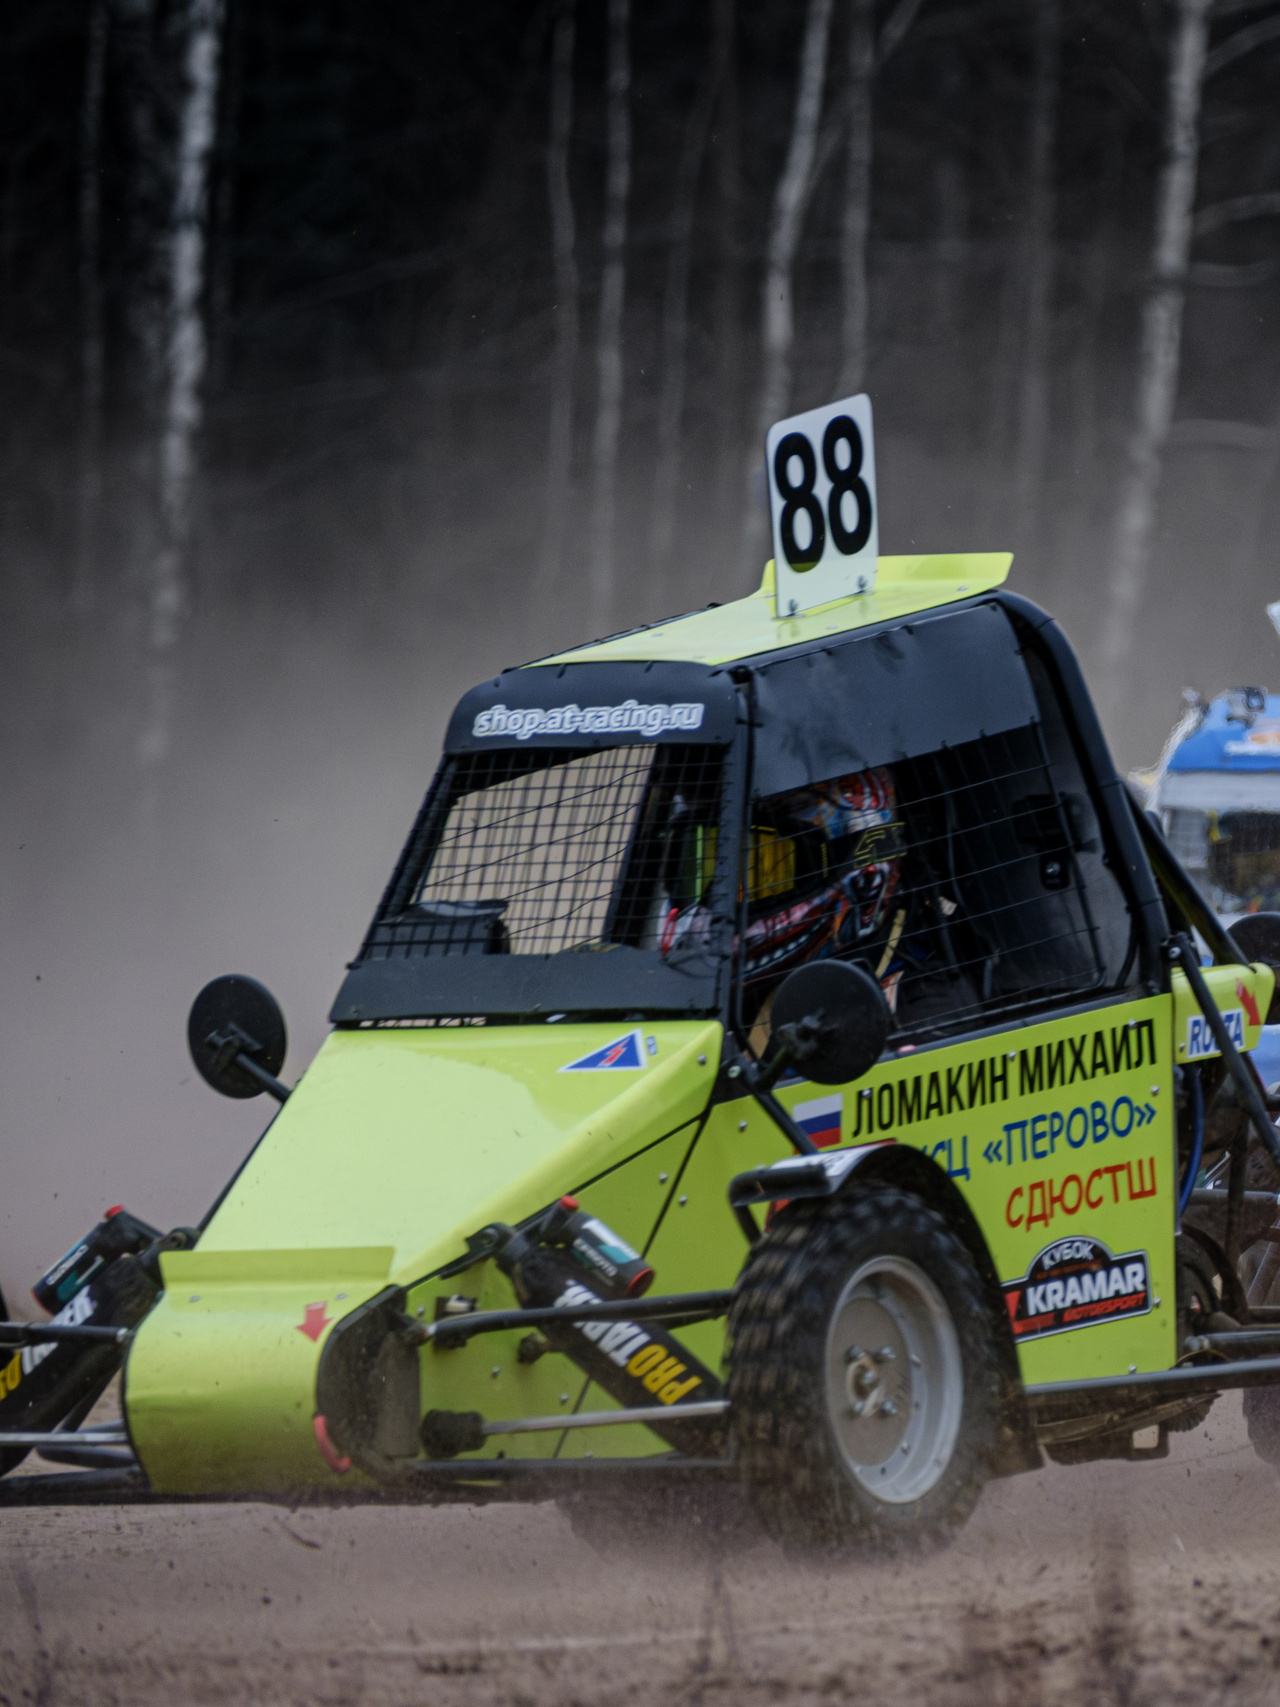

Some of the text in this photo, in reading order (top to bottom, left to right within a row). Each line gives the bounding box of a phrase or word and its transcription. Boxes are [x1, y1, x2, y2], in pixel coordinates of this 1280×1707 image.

[774, 415, 872, 573] 88
[473, 700, 704, 740] shop.at-racing.ru
[852, 1018, 1157, 1139] ЛОМАКИН МИХАИЛ
[982, 1095, 1156, 1166] «ПЕРОВО»
[1005, 1156, 1157, 1232] СДЮСТШ
[1026, 1262, 1146, 1316] KRAMAR
